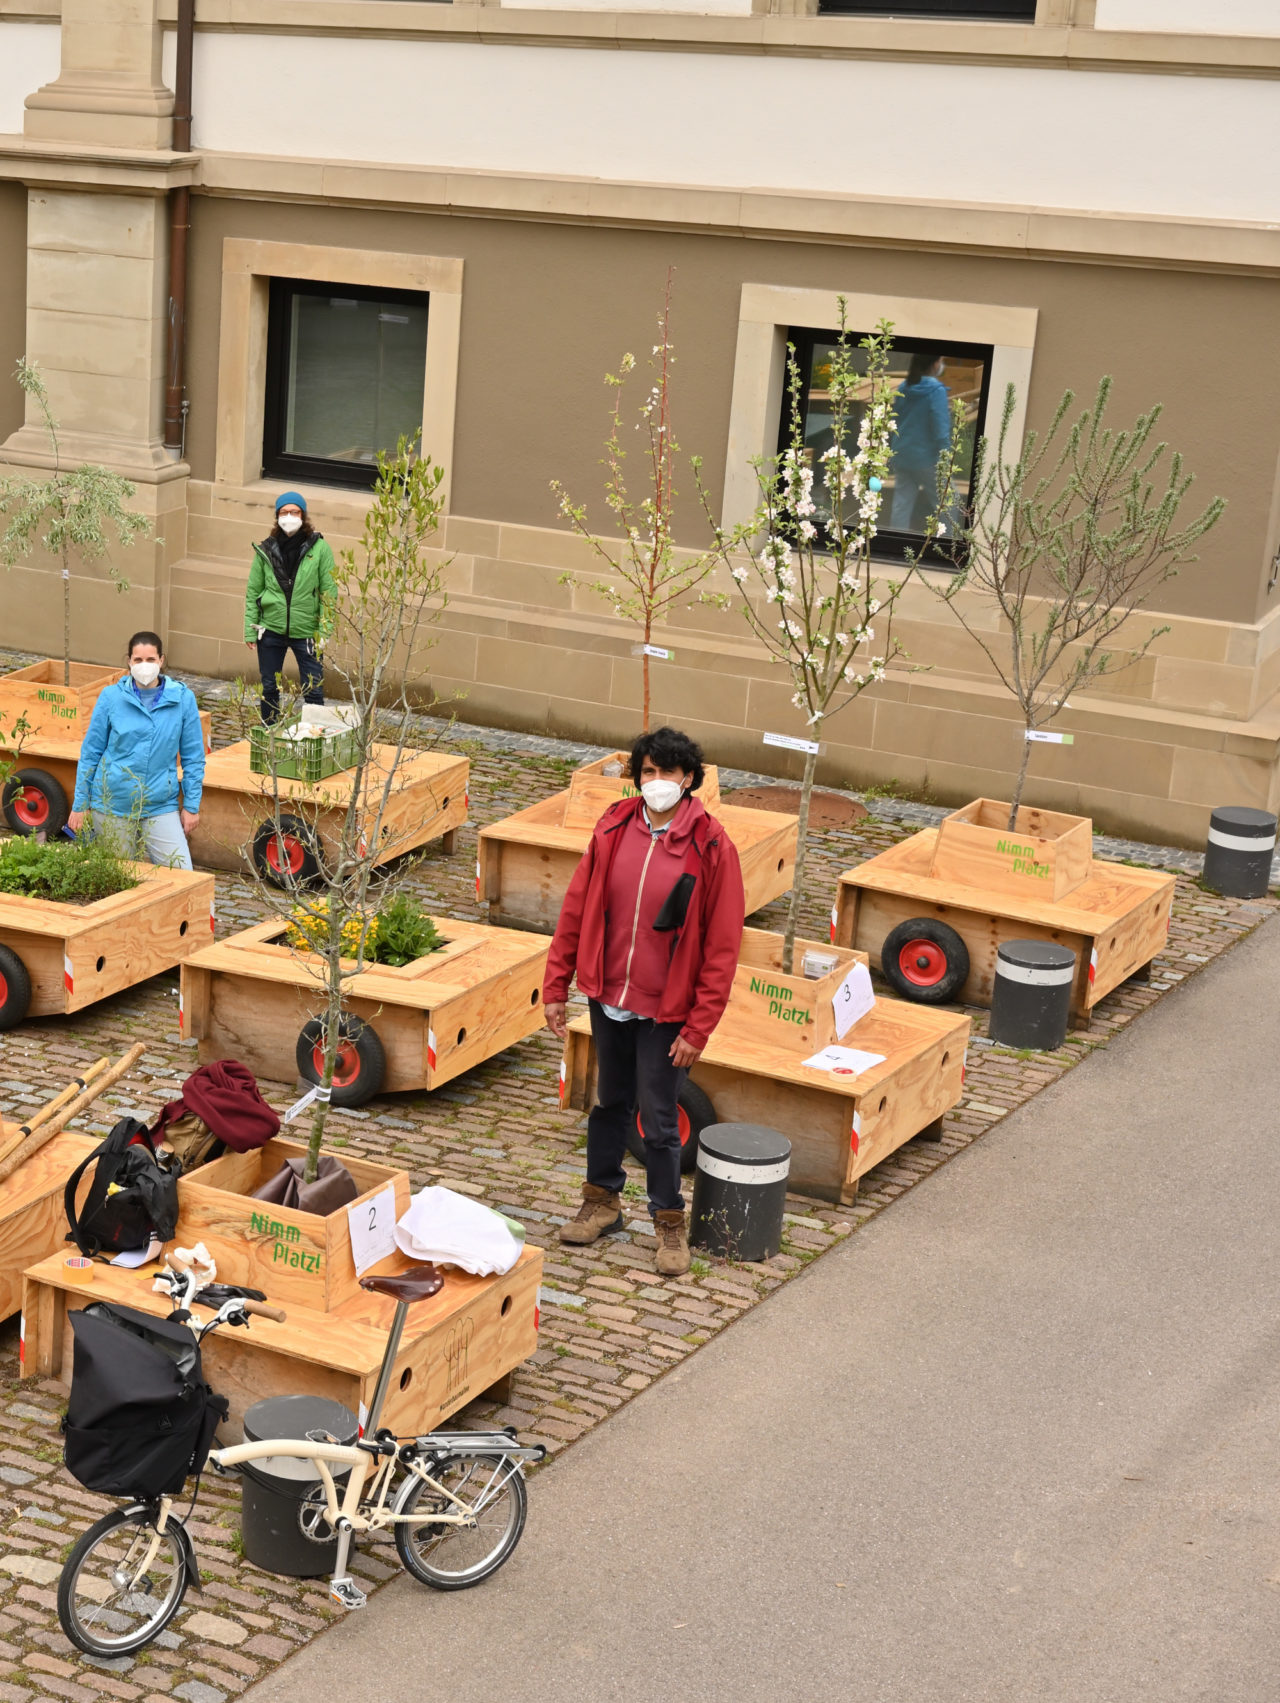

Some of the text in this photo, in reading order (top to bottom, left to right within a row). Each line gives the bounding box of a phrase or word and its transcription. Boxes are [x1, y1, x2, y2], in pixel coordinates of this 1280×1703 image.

[38, 689, 66, 704] Nimm
[51, 704, 77, 719] Platz!
[996, 839, 1035, 858] Nimm
[1013, 858, 1050, 879] Platz!
[750, 976, 793, 1001] Nimm
[844, 984, 851, 1002] 3
[769, 1000, 809, 1025] Platz!
[251, 1211, 301, 1243] Nimm
[368, 1206, 377, 1231] 2
[273, 1242, 321, 1274] Platz!
